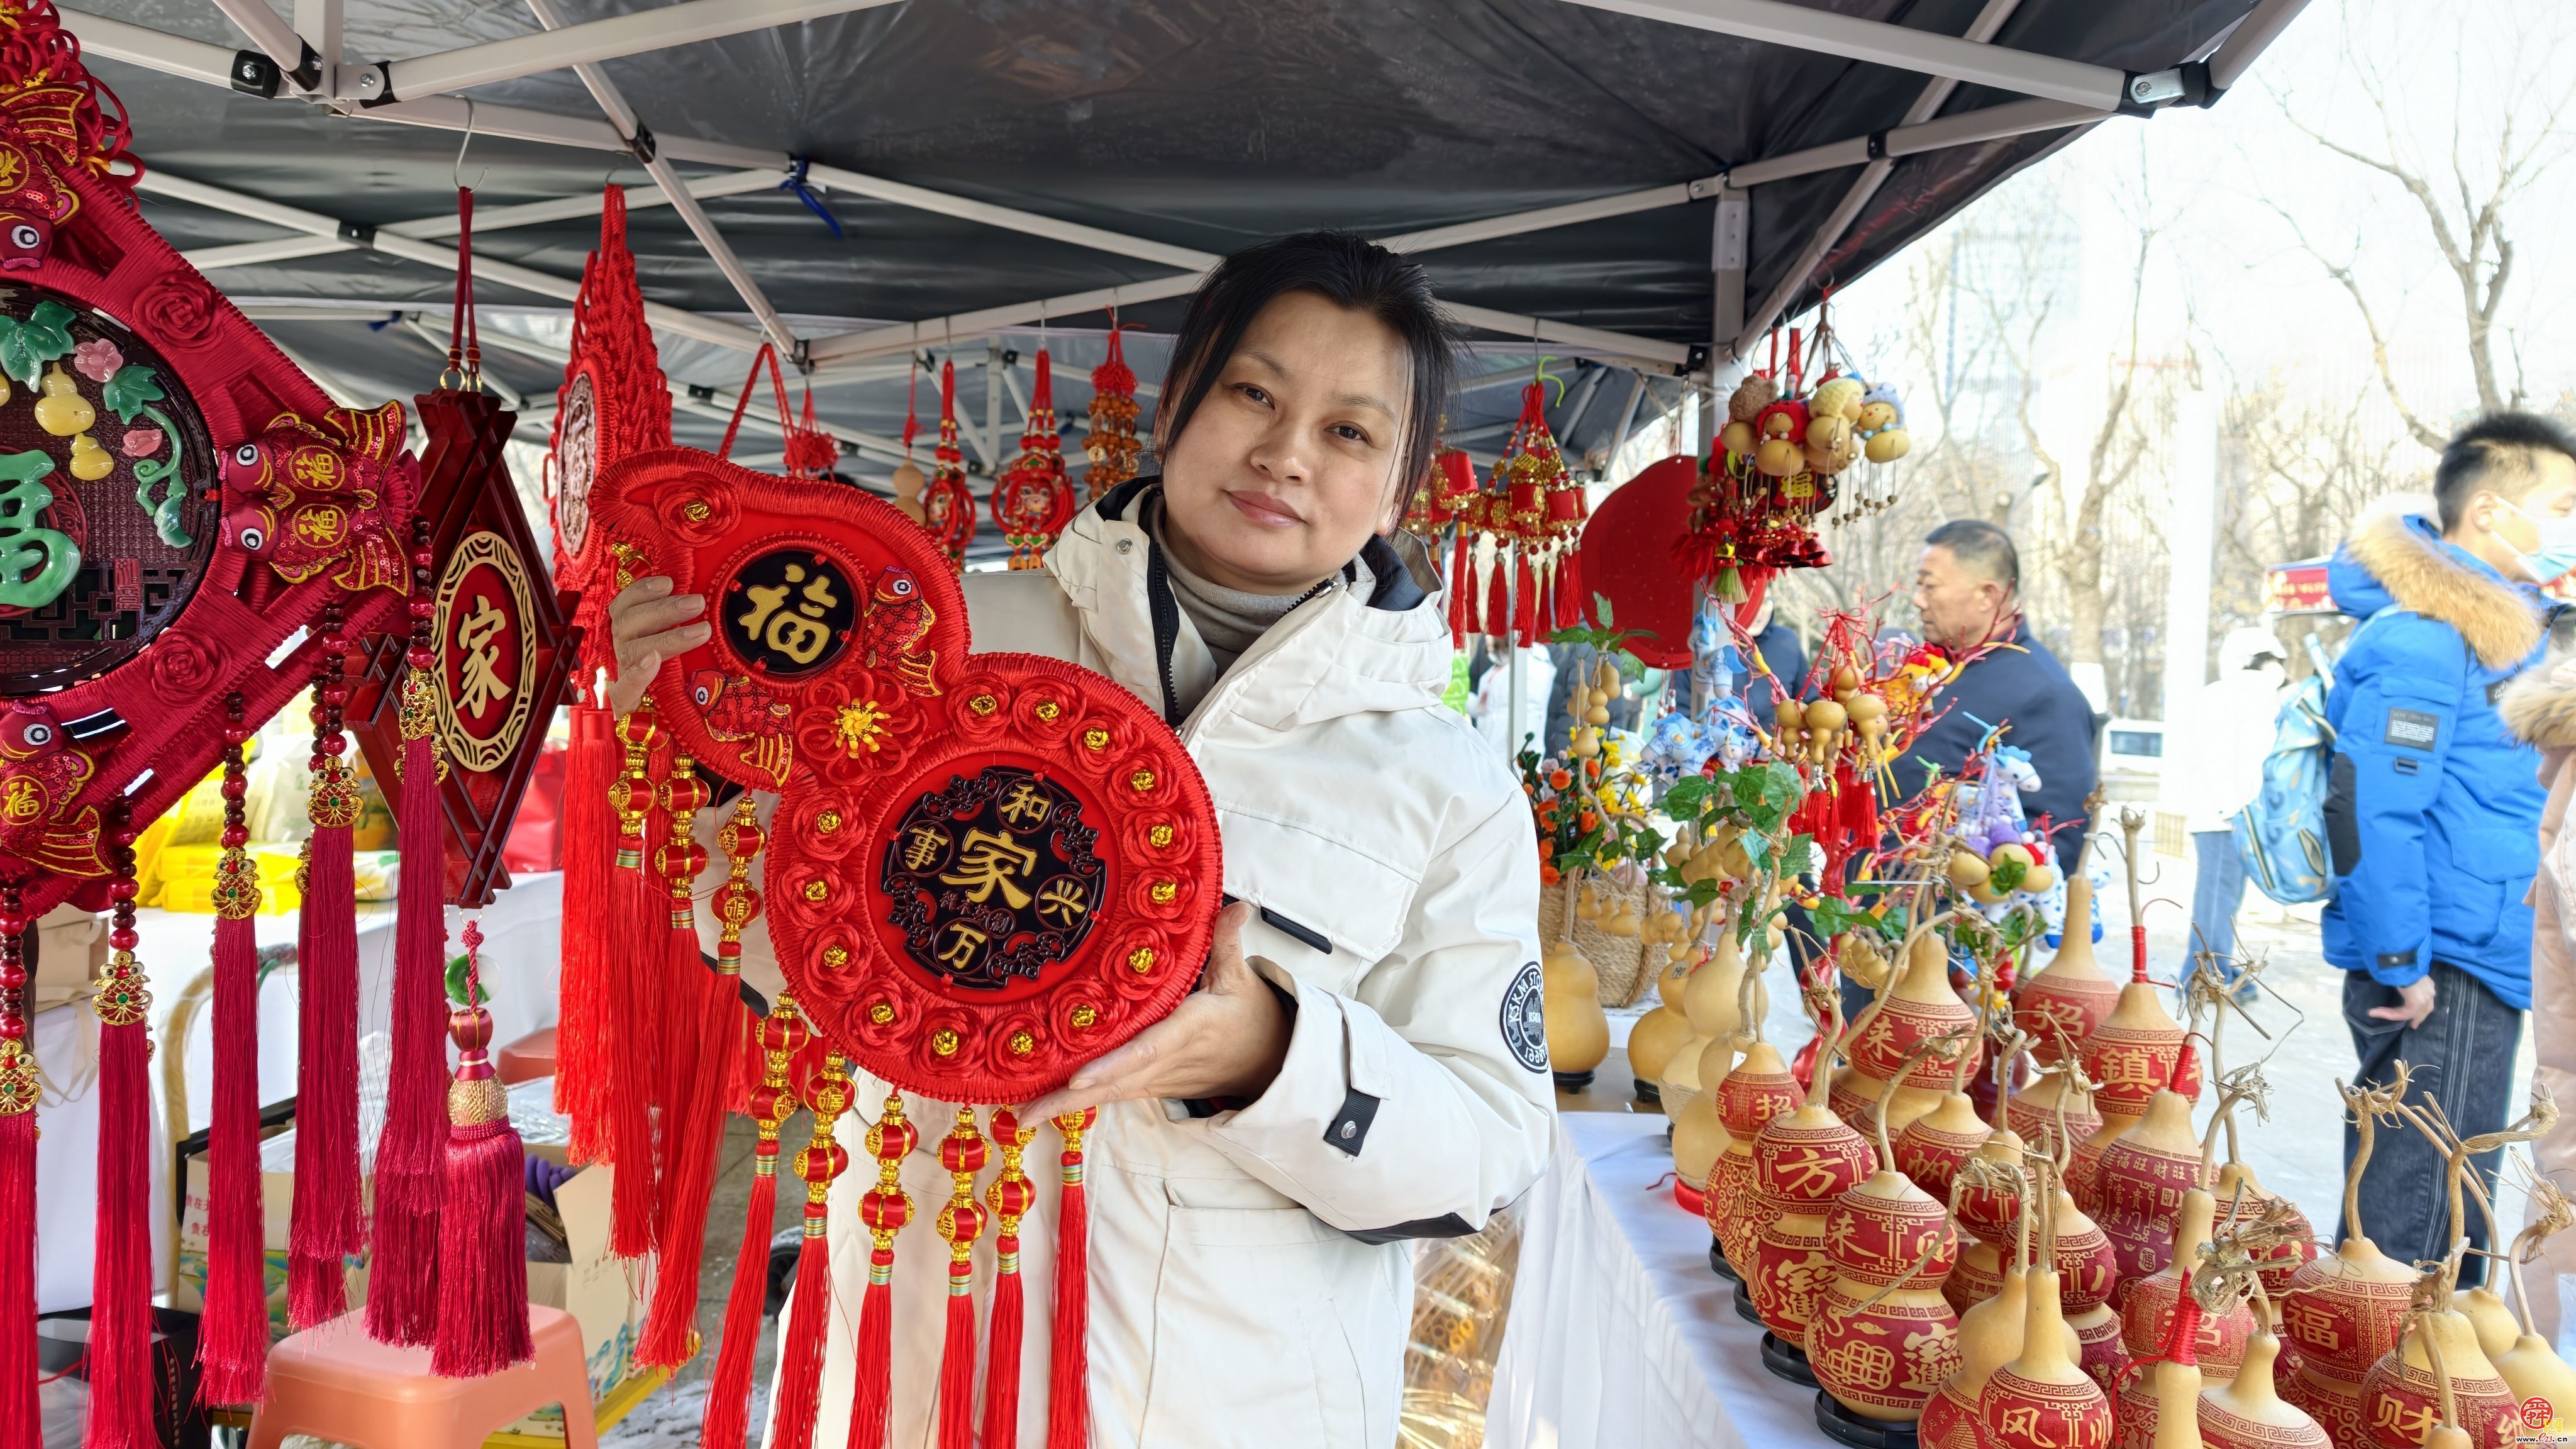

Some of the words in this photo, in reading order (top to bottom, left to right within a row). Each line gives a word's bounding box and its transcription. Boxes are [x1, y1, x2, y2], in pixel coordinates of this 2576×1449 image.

[295, 453, 336, 487] 福
[299, 508, 338, 543] 福
[738, 562, 838, 665] 福
[455, 594, 511, 720] 家
[2, 781, 40, 818] 福
[1000, 784, 1052, 824] 和
[904, 827, 948, 870] 事
[940, 826, 1038, 909] 家
[1039, 878, 1087, 926] 兴
[938, 921, 987, 969] 万
[1862, 1014, 1913, 1062] 来
[2031, 998, 2086, 1037] 招
[2099, 1046, 2162, 1095] 鎮
[1775, 1148, 1846, 1199] 方
[1826, 1211, 1882, 1258] 来
[2284, 1299, 2340, 1350] 福
[1999, 1406, 2057, 1448] 风
[2372, 1393, 2441, 1445] 财
